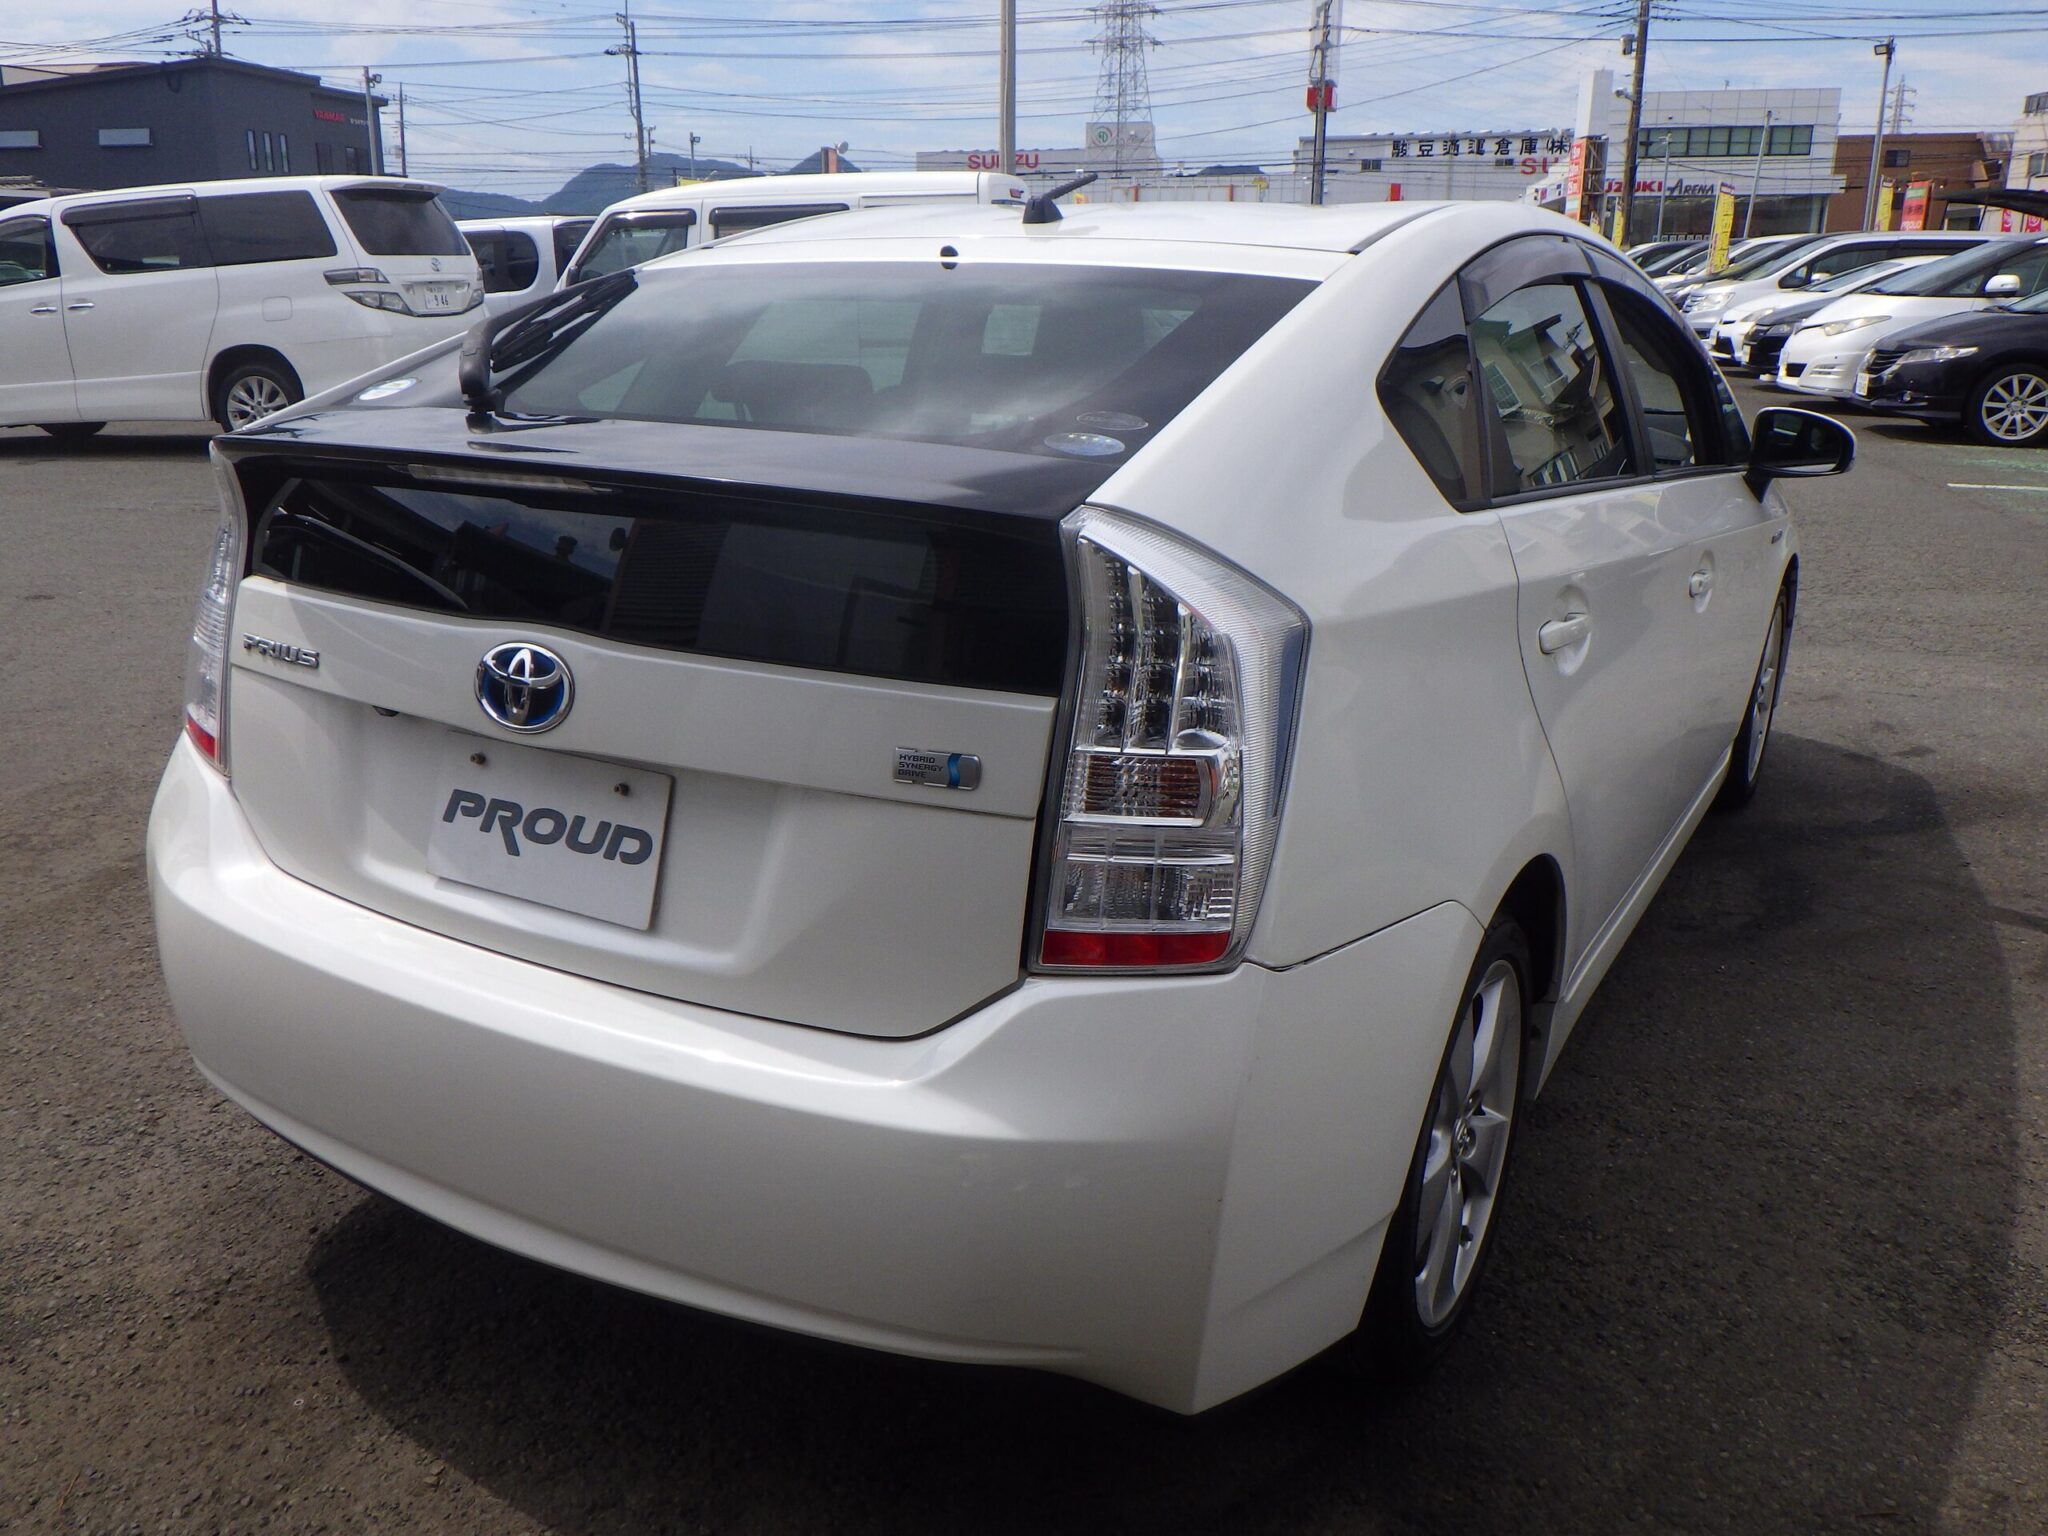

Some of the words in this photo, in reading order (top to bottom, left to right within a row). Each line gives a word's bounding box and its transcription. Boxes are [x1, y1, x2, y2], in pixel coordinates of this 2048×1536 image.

[967, 153, 1039, 170] SUZU
[1667, 178, 1715, 195] ARENA
[242, 632, 320, 669] PRIUS
[898, 761, 944, 772] SYNERGY
[899, 754, 936, 764] HYBRID
[897, 768, 927, 779] DRIVE
[442, 788, 653, 865] PROUD
